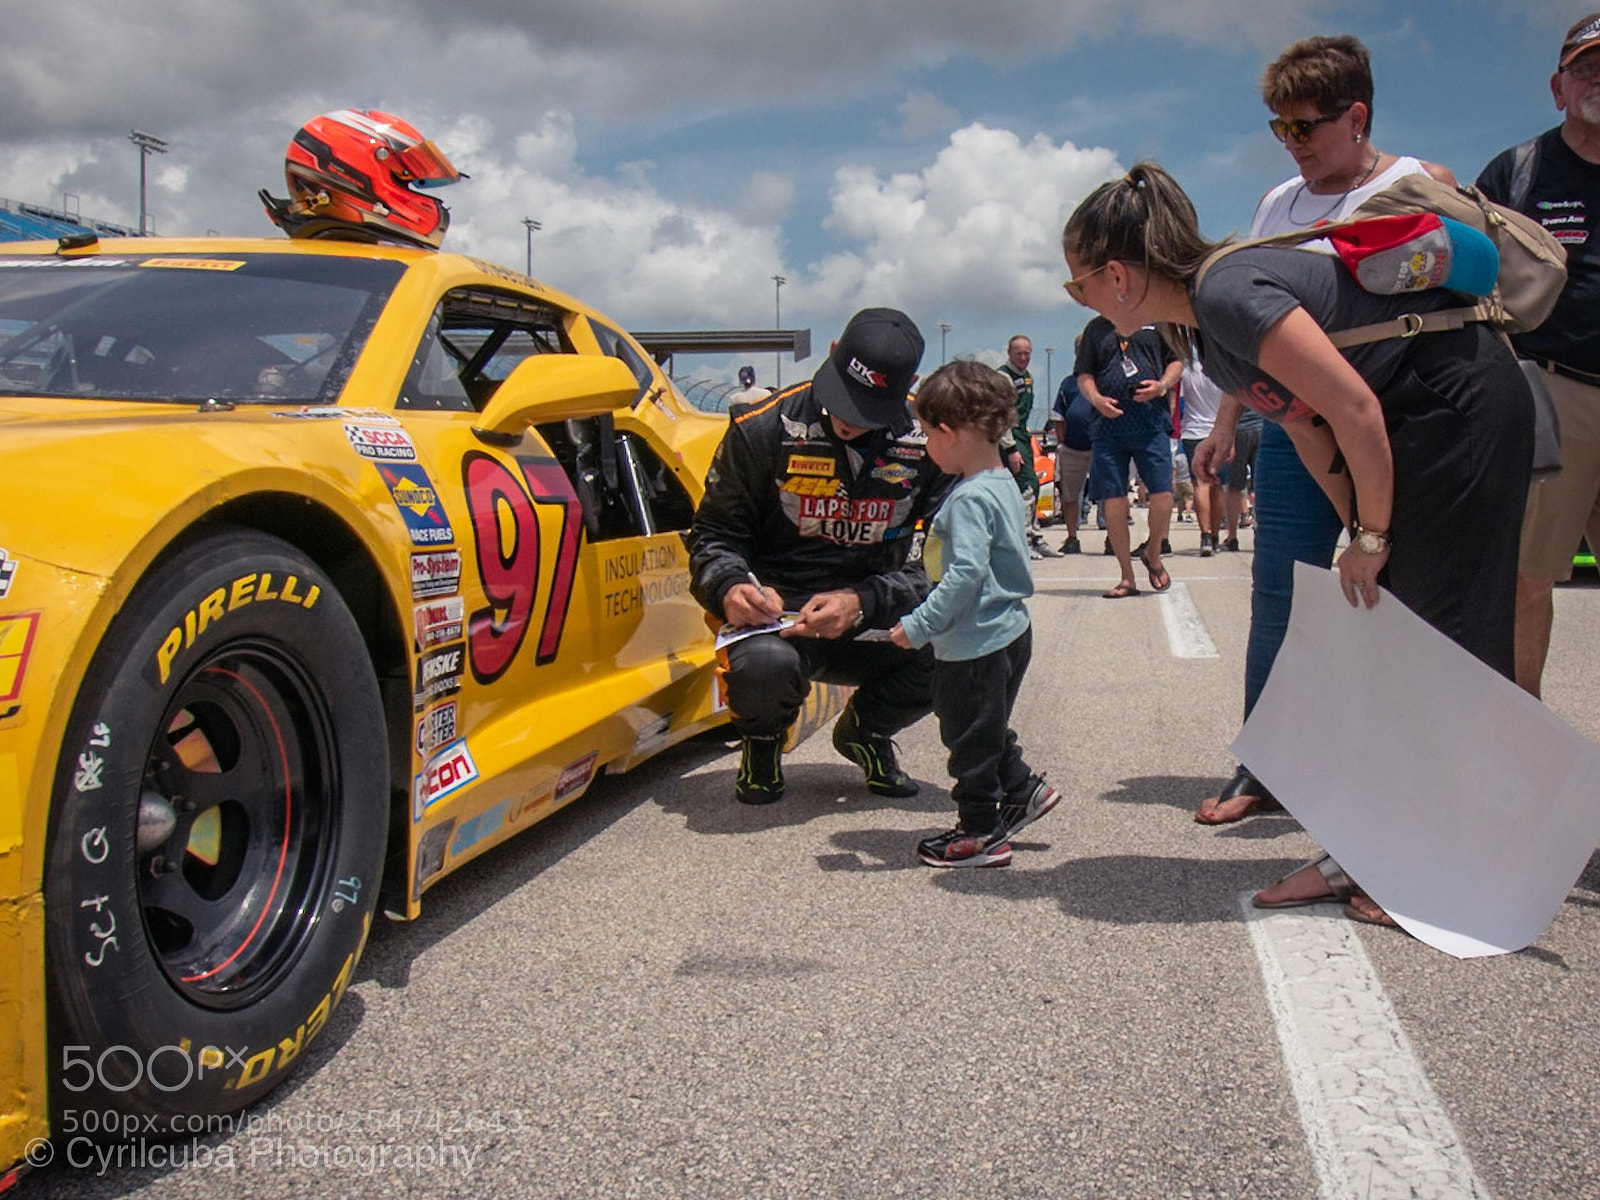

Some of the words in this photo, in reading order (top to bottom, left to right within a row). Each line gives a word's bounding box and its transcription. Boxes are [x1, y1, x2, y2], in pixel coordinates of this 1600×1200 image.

[362, 430, 409, 445] SCCA
[356, 444, 376, 455] PRO
[376, 445, 414, 458] RACING
[395, 488, 434, 504] SUNOCO
[858, 501, 890, 520] FOR
[428, 527, 453, 541] FUELS
[821, 520, 872, 542] LOVE
[461, 449, 584, 685] 97
[604, 544, 677, 583] INSULATION
[604, 570, 691, 619] TECHNOLOGIE
[156, 573, 321, 685] PIRELLI
